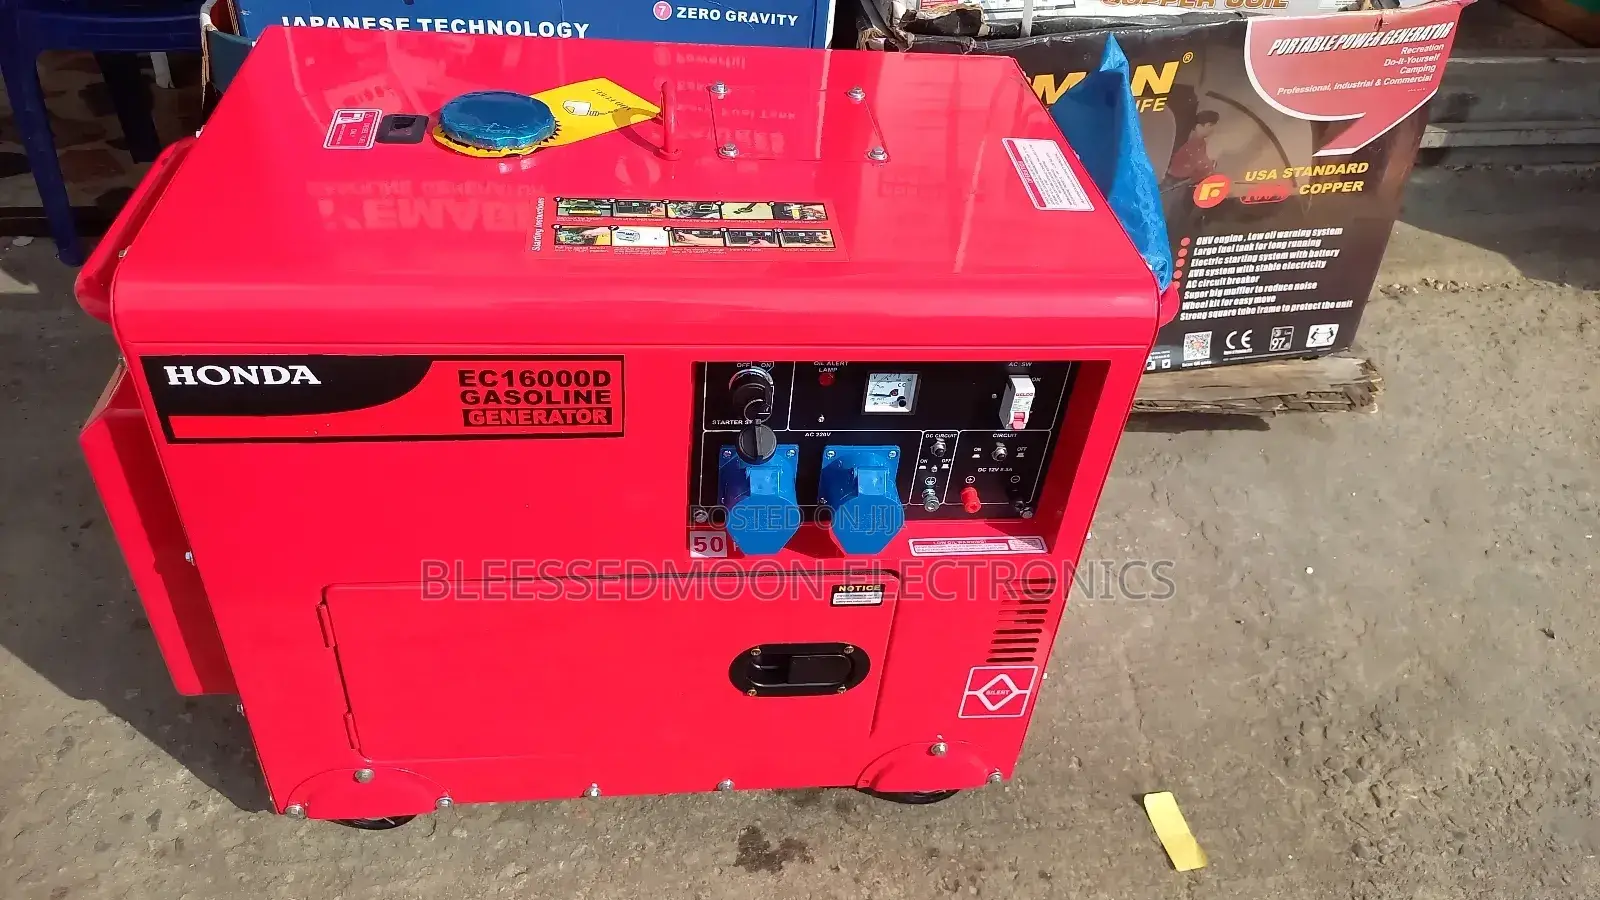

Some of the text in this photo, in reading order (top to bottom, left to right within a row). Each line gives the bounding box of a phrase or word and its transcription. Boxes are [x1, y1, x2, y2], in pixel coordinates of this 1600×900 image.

[676, 6, 721, 21] ZERO
[725, 10, 798, 27] GRAVITY
[416, 18, 590, 40] TECHNOLOGY
[1267, 22, 1454, 56] PORTABLE POWER GENERATOR
[1400, 43, 1444, 54] Recreation
[1400, 64, 1436, 74] Camping
[1384, 74, 1432, 86] Commercial
[1244, 162, 1369, 182] USA STANDARD
[1300, 180, 1364, 195] COPPER
[1247, 232, 1264, 241] Low
[1312, 228, 1344, 237] system
[1193, 238, 1322, 256] Large fuel tank for long running
[1190, 249, 1340, 267] Electric starting system with battery
[1205, 267, 1235, 276] system
[1236, 264, 1254, 274] with
[1255, 262, 1281, 271] stable
[1282, 260, 1327, 270] electricity
[1184, 290, 1209, 300] Super
[1209, 288, 1223, 298] big
[1255, 285, 1264, 293] to
[1264, 283, 1294, 292] reduce
[1294, 281, 1318, 290] noise
[1185, 275, 1260, 289] AC circuit breaker
[1180, 300, 1353, 321] Strong square tube frame to protect the unit
[1182, 295, 1276, 310] Wheel kit for easy move
[1226, 329, 1252, 349] CE
[1272, 337, 1286, 350] 97
[164, 364, 322, 386] HONDA
[458, 369, 612, 388] EC16000D
[460, 389, 612, 405] GASOLINE
[468, 409, 608, 425] GENERATOR
[693, 536, 724, 553] 50
